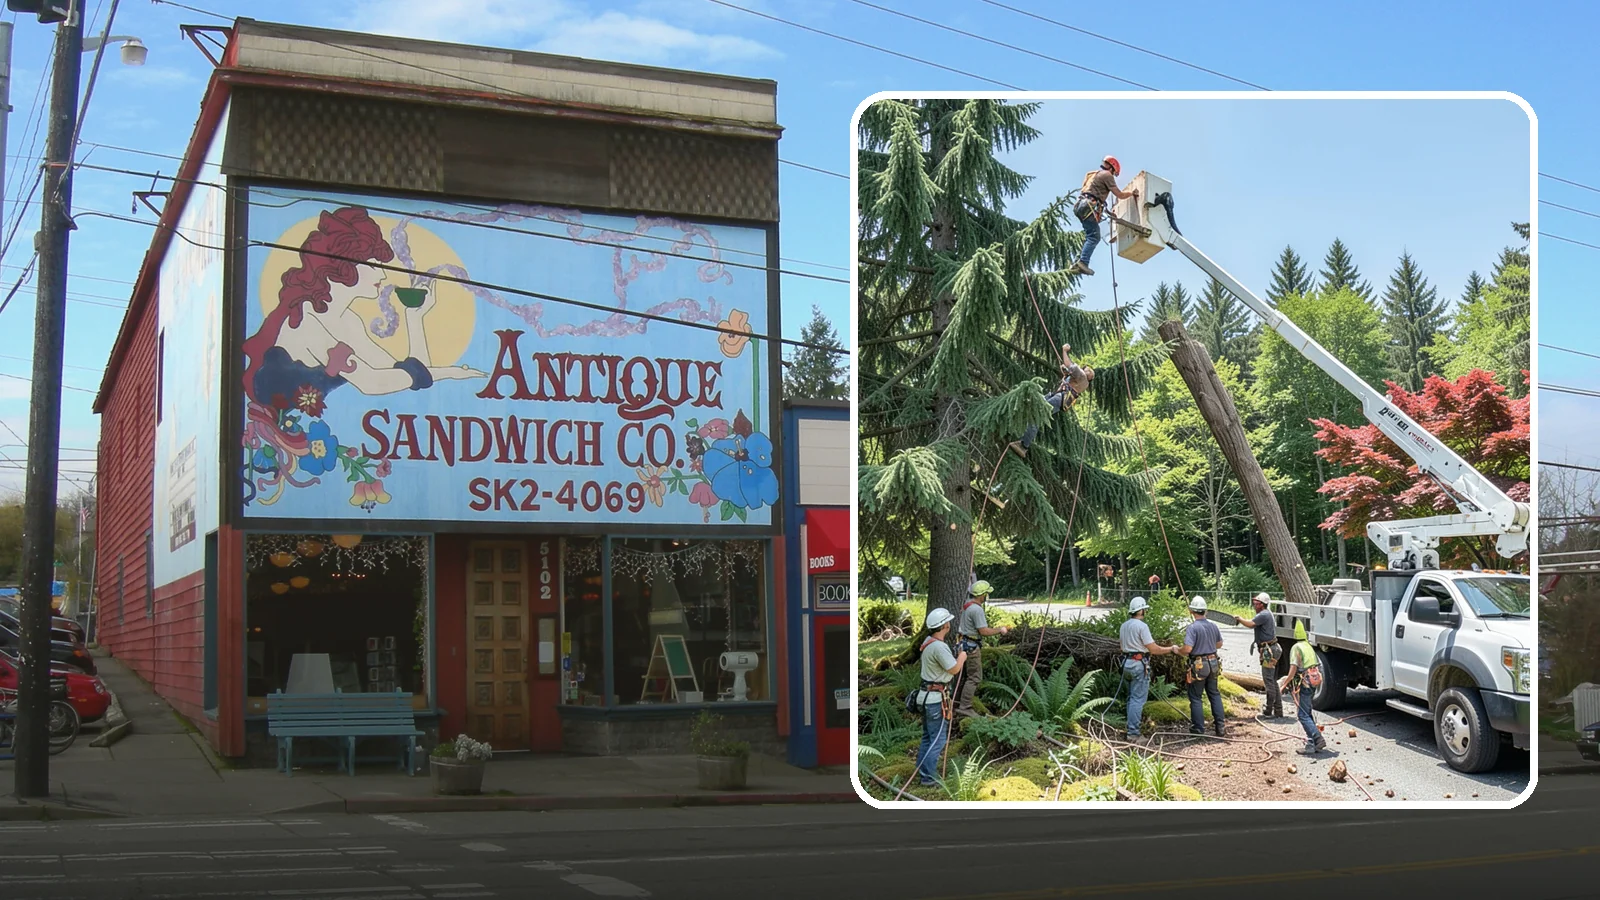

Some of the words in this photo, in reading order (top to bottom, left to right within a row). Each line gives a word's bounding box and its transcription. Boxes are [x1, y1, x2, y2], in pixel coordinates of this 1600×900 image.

[476, 329, 724, 421] ANTIQUE
[361, 408, 605, 467] SANDWICH
[617, 422, 685, 469] CO.
[468, 477, 646, 512] SK2-4069
[539, 542, 551, 600] 5102
[809, 555, 835, 569] BOOKS
